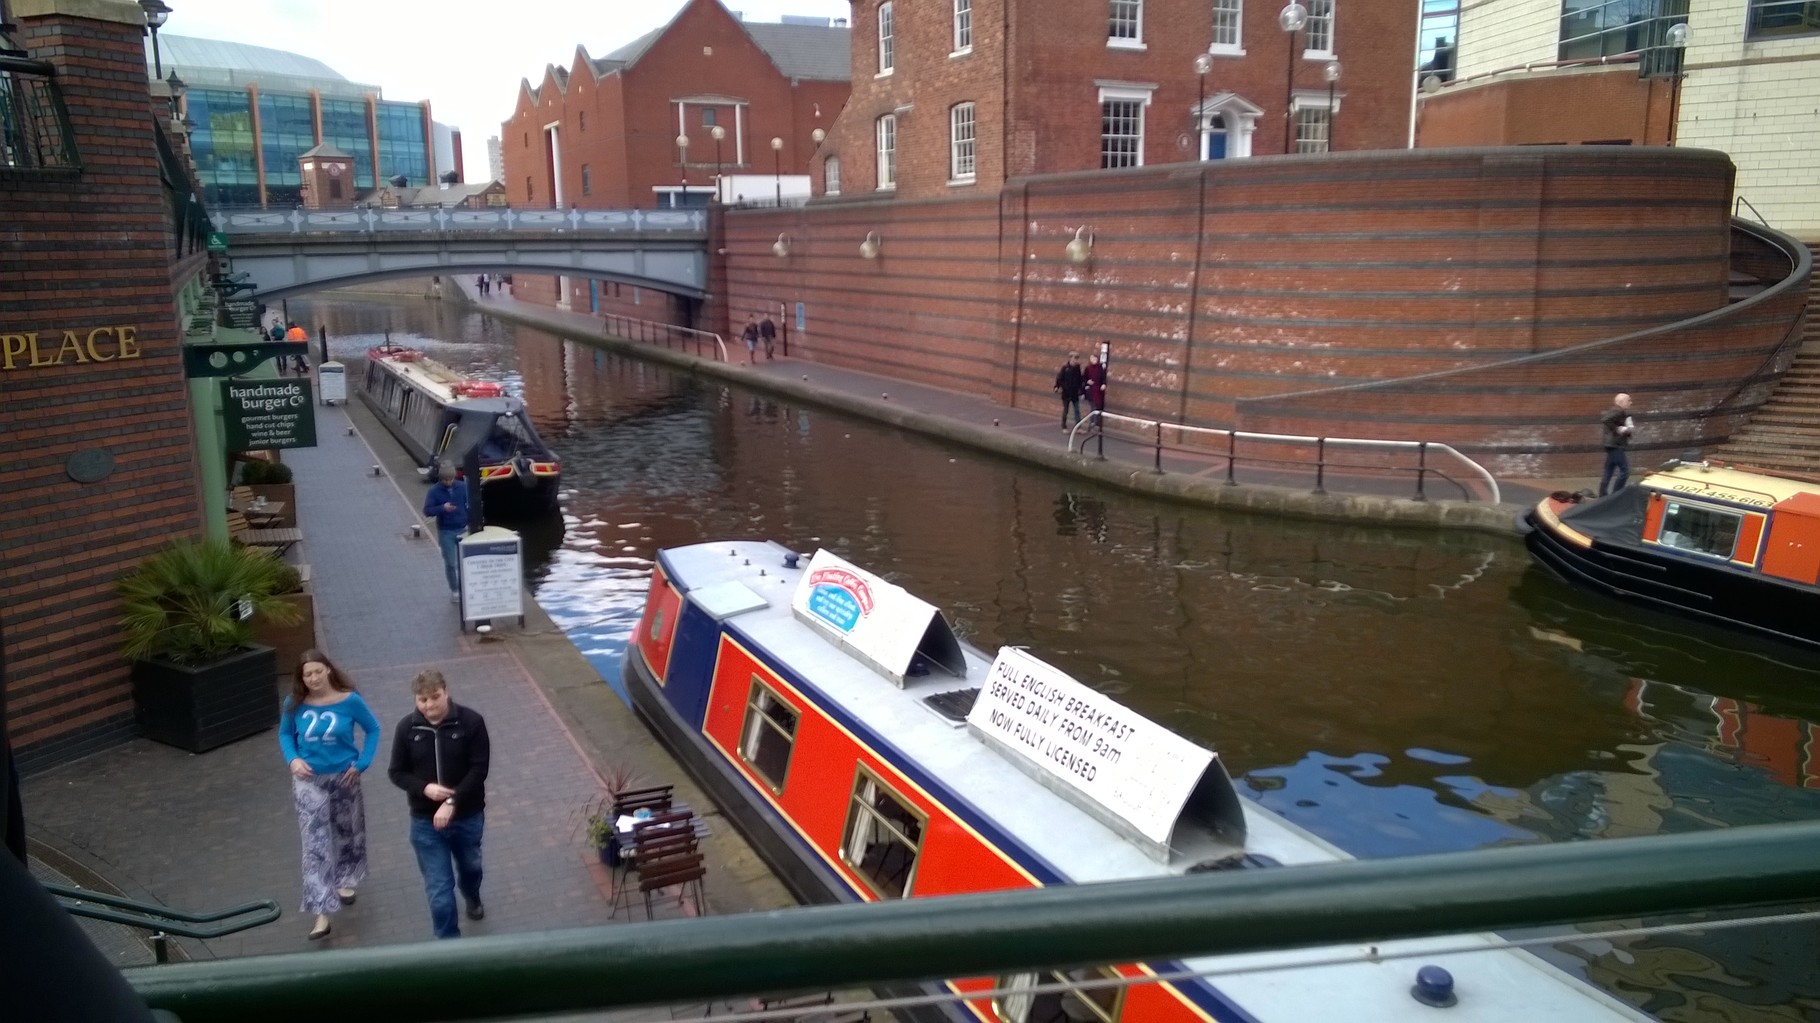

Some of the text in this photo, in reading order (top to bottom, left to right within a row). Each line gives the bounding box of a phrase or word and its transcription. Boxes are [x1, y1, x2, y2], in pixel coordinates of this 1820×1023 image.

[0, 326, 140, 370] PLACE
[229, 383, 300, 398] handmade
[242, 397, 287, 411] burger
[241, 413, 298, 423] gourmet burgers
[246, 422, 264, 430] hand
[276, 421, 295, 430] chips
[248, 437, 296, 447] junior burgers
[998, 661, 1135, 742] FULL ENGLISH BREAKFAST
[302, 709, 337, 742] 22
[990, 681, 1121, 764] SERVED DAILY FROM 9am
[989, 708, 1097, 782] NOW FULLY LICENSED
